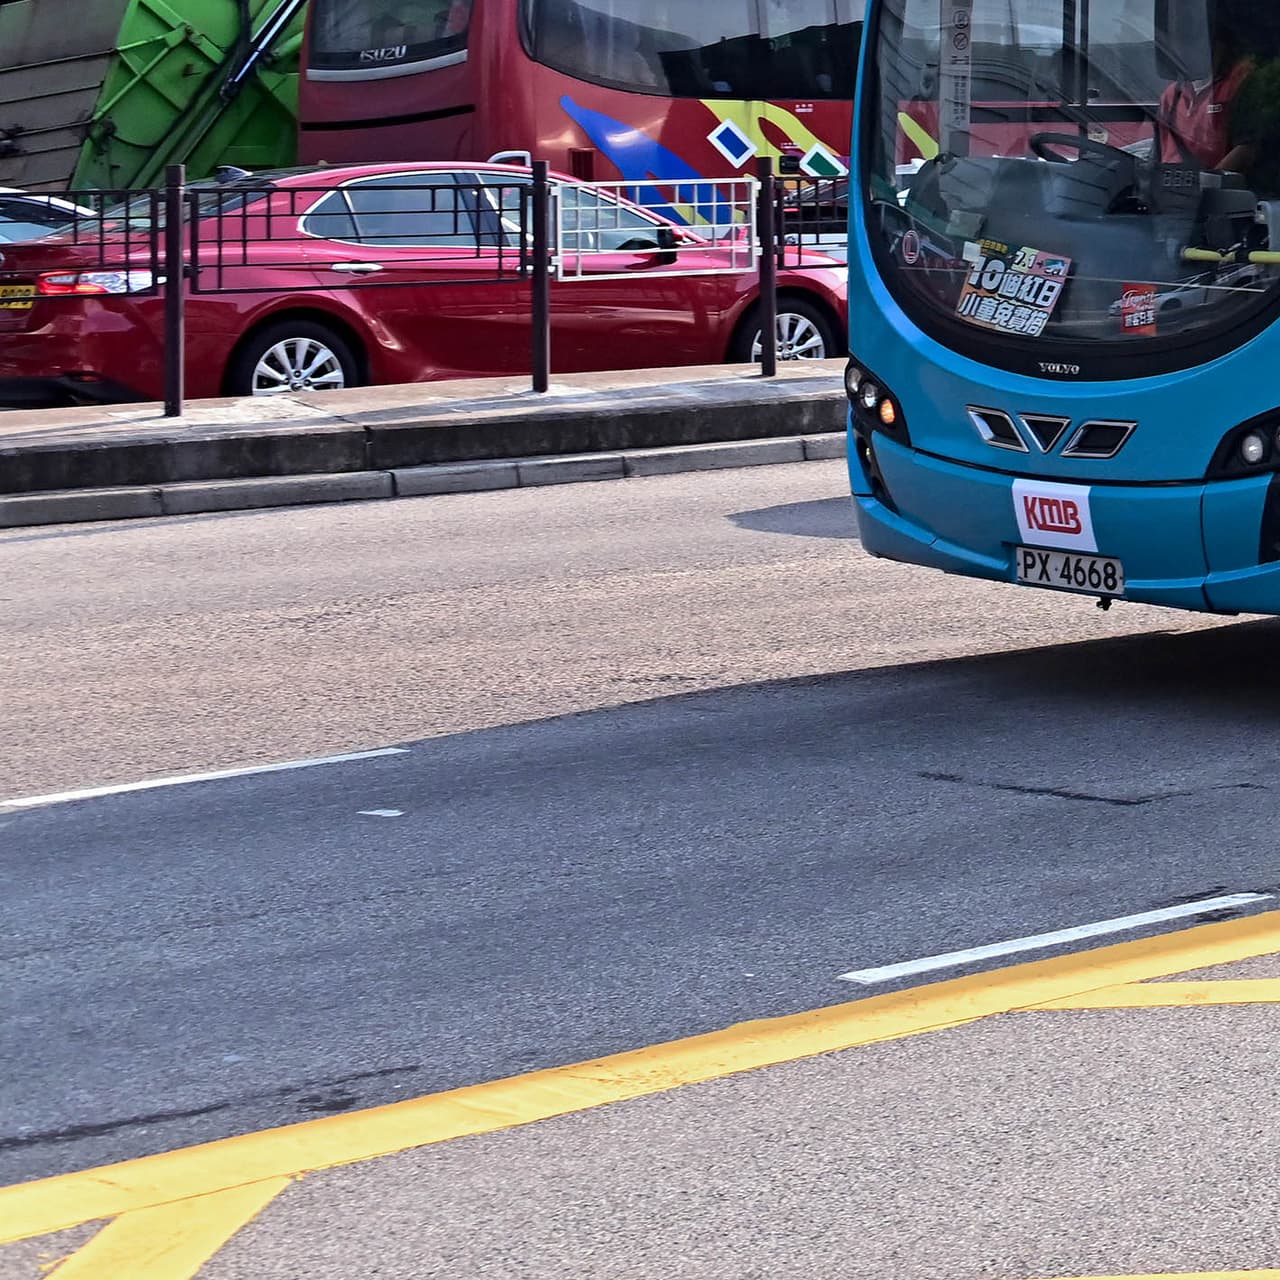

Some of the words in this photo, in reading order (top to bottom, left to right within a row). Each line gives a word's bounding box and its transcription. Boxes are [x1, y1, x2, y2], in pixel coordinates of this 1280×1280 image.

[360, 44, 407, 61] ISUZU
[1038, 361, 1081, 375] VOLVO
[1023, 495, 1082, 535] KMB
[1023, 550, 1052, 583] PX
[1060, 555, 1118, 591] 4668
